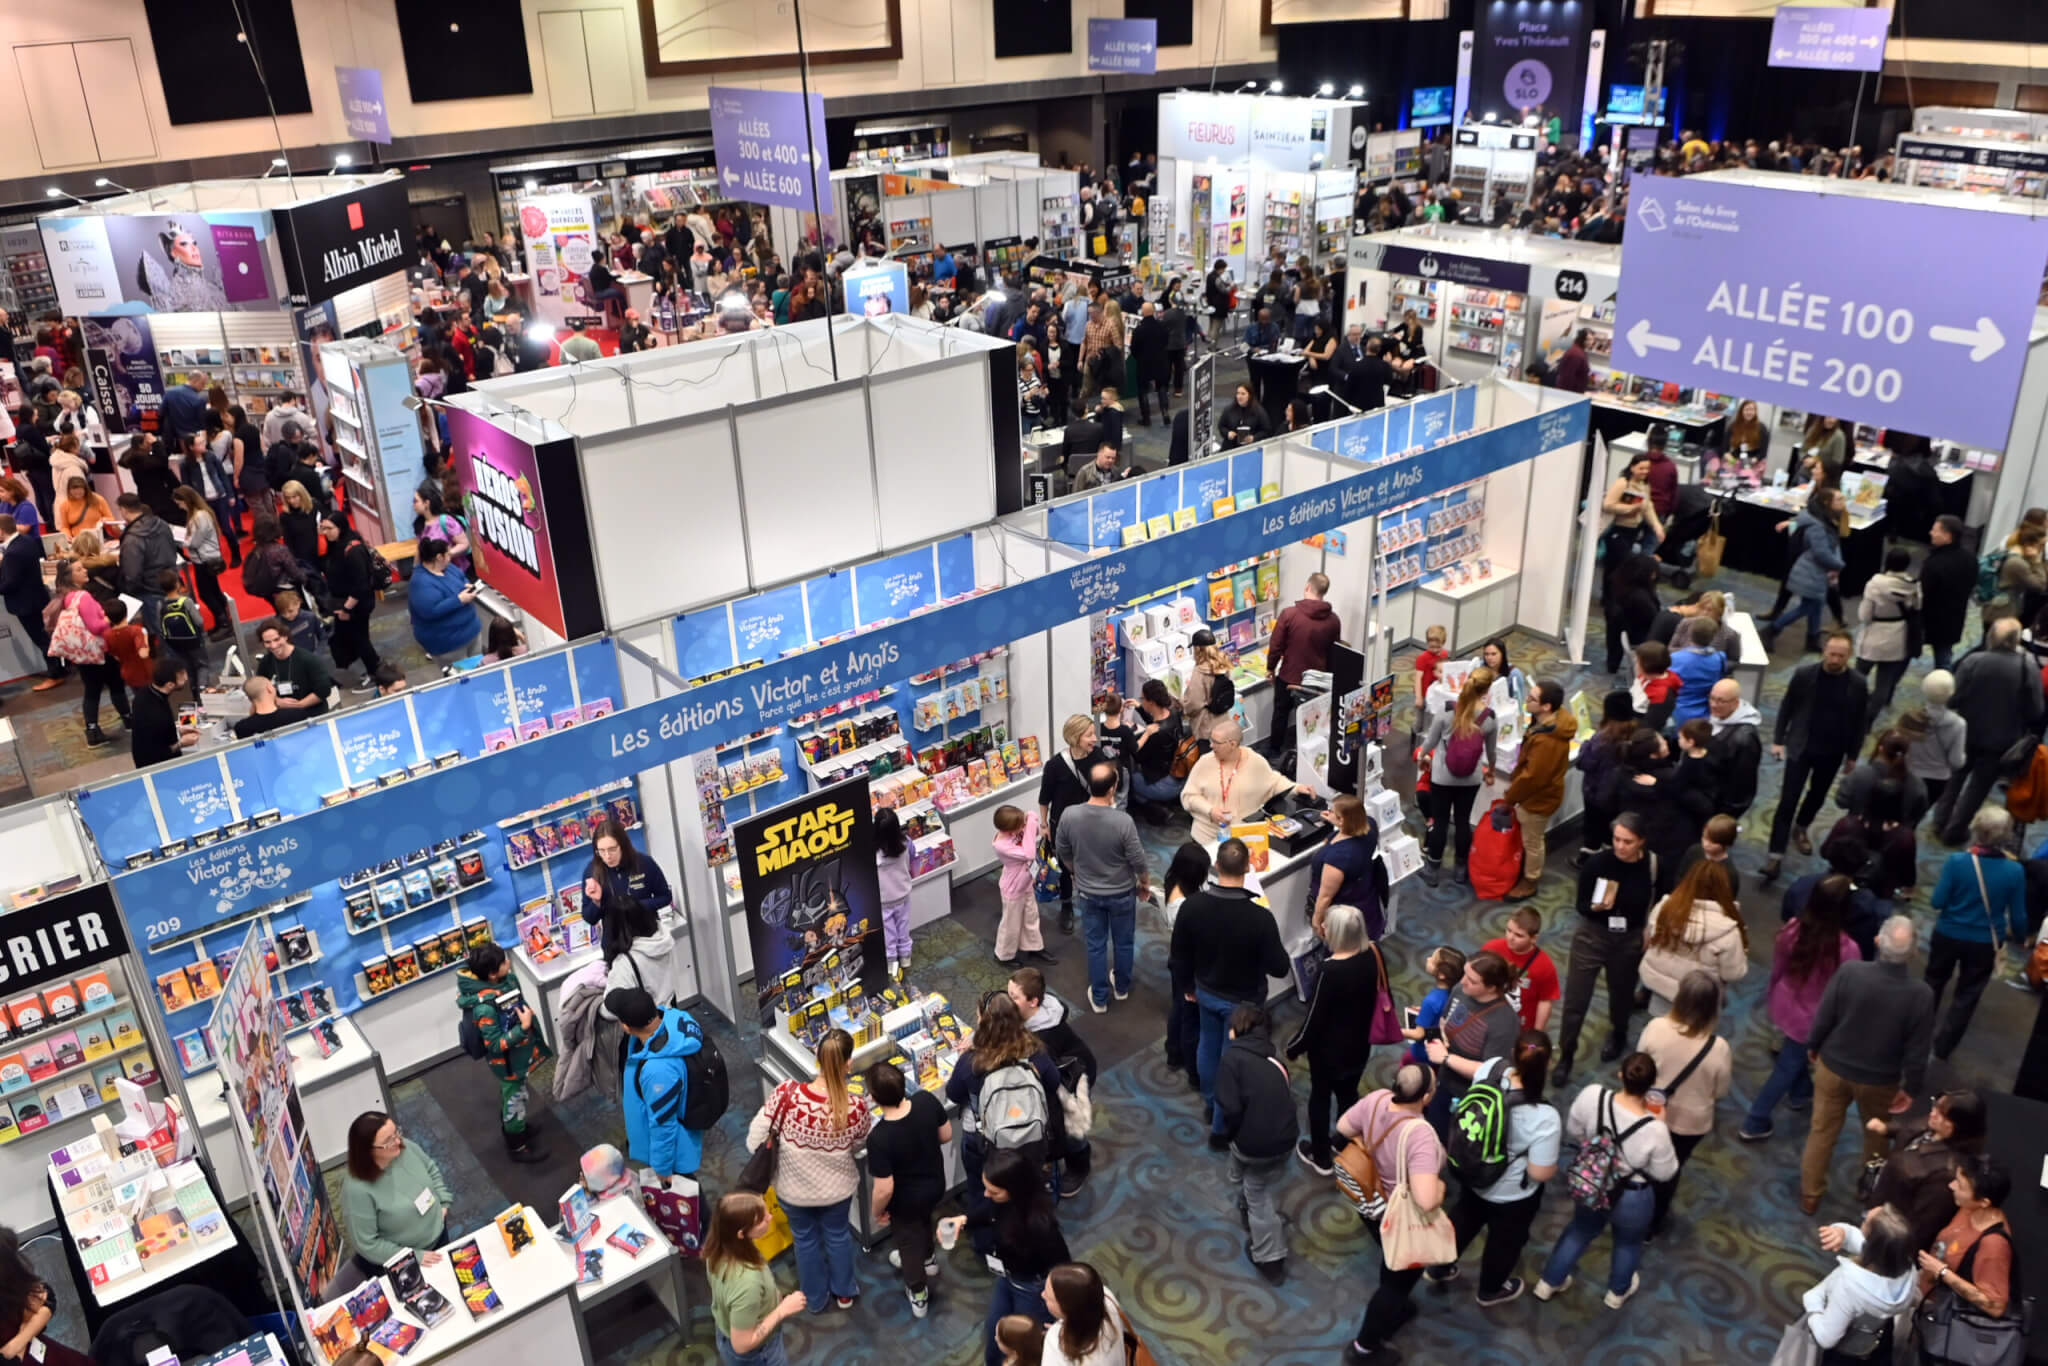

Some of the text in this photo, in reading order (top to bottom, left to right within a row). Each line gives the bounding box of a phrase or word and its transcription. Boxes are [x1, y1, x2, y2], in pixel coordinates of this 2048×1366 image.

[1494, 34, 1570, 47] Yves Thériault
[1518, 21, 1549, 33] Place
[1514, 87, 1540, 100] SLO
[738, 117, 771, 138] ALLÉES
[1188, 121, 1236, 145] FLEURUS
[738, 140, 798, 165] 300 et 400
[743, 168, 802, 196] ALLÉE 600
[1673, 213, 1685, 225] de
[1674, 199, 1738, 218] Salon du livre
[323, 228, 404, 284] Albin Michel
[1558, 276, 1585, 295] 214
[1705, 279, 1915, 345] ALLÉE 100
[1691, 334, 1903, 403] ALLÉE 200
[94, 363, 115, 416] Caisse
[472, 453, 523, 518] HÉROS
[1262, 466, 1423, 536] Les éditions Victor et Anaïs
[471, 492, 541, 578] FUSION
[1070, 561, 1126, 590] Victor et Anaïs
[609, 640, 901, 759] Les éditions Victor et Anaïs
[759, 705, 784, 723] Parce
[786, 699, 802, 715] que
[804, 691, 819, 704] lire
[821, 685, 841, 699] c'est
[844, 674, 873, 693] grandir
[177, 790, 206, 806] Victor
[207, 786, 218, 798] et
[755, 802, 855, 854] STAR
[187, 836, 299, 885] Victor et Anaïs
[189, 844, 247, 870] Les éditions
[757, 816, 856, 877] MIAOU
[145, 916, 182, 941] 209
